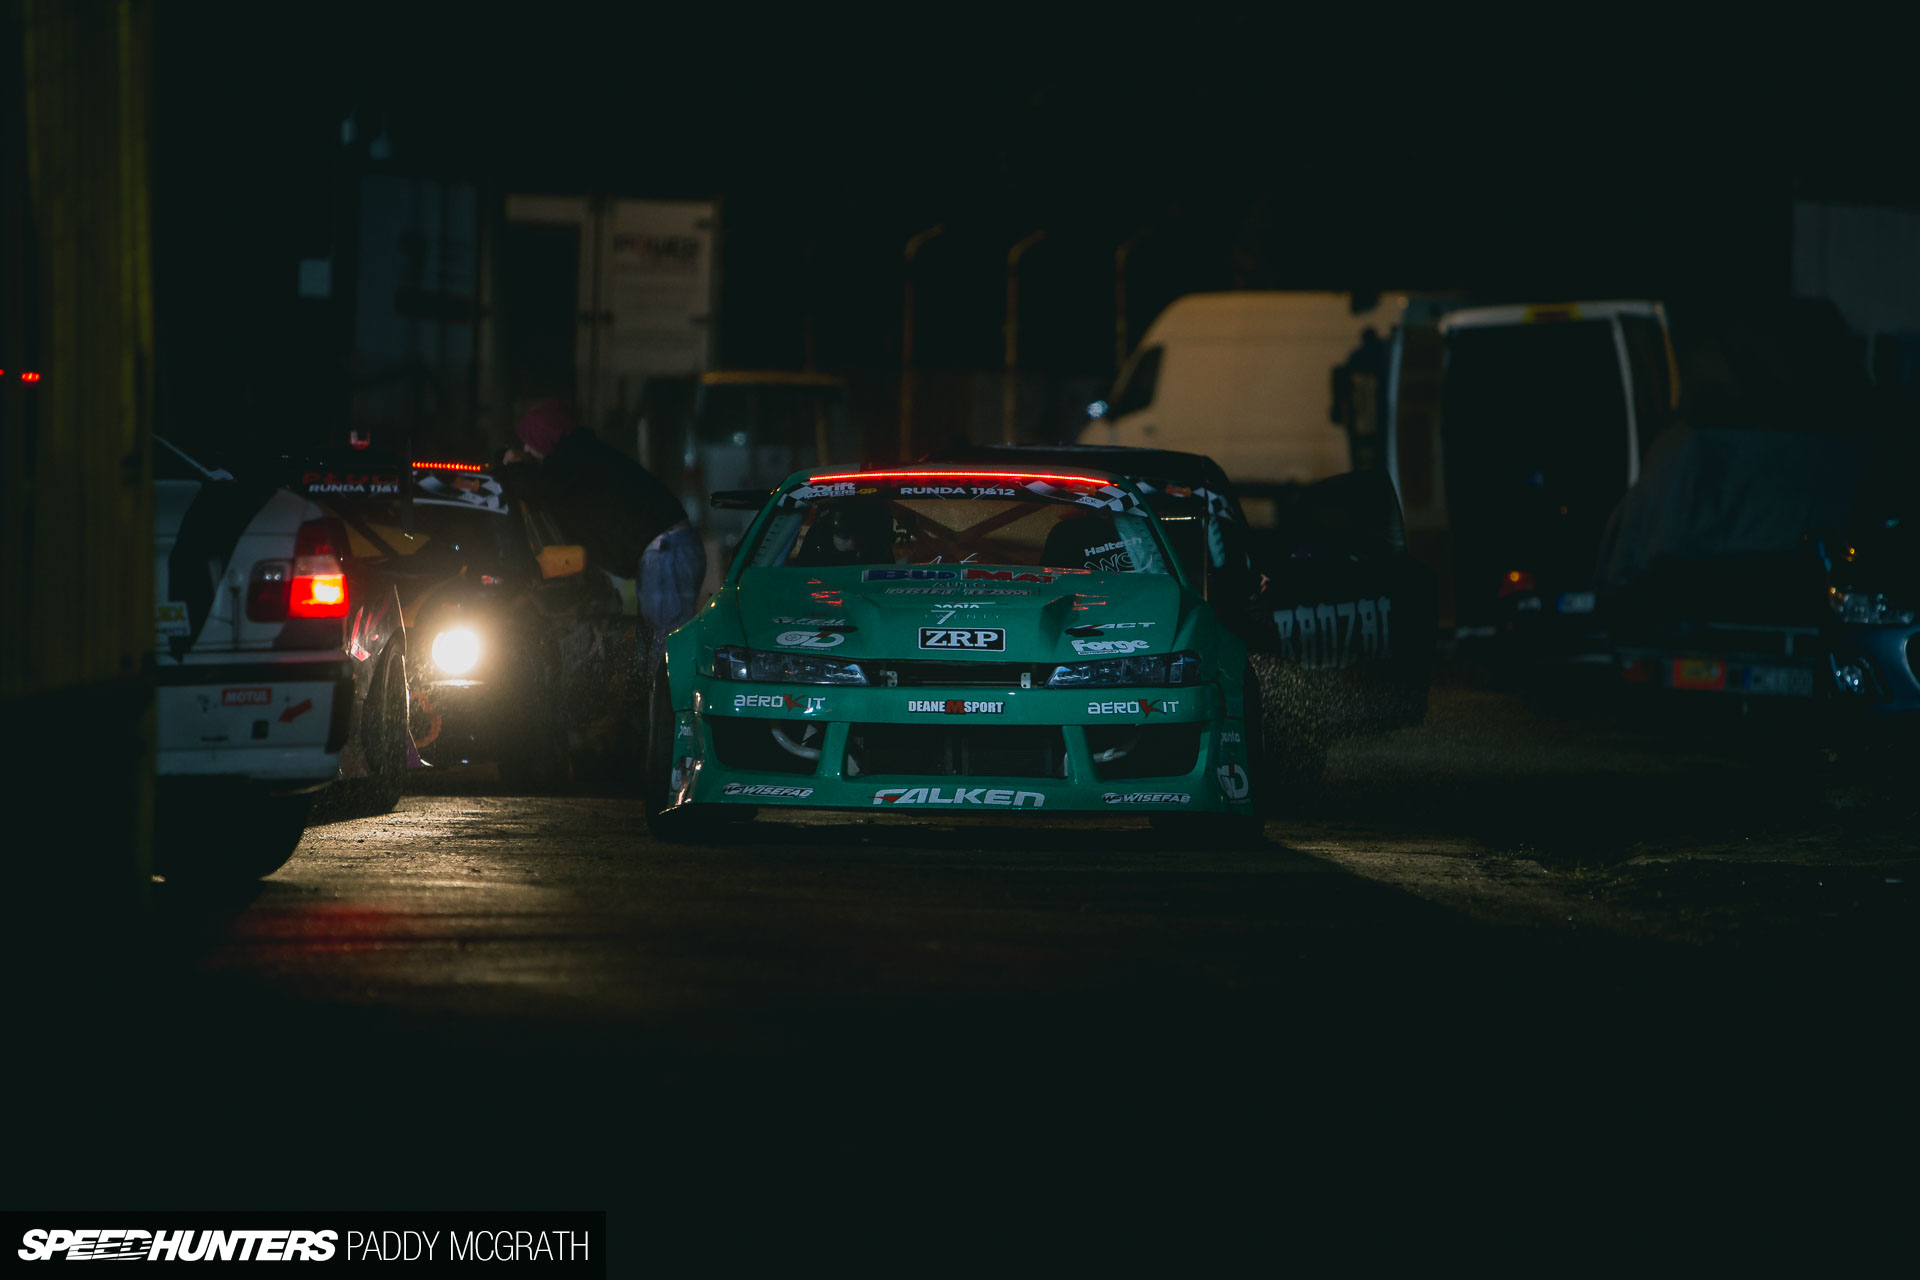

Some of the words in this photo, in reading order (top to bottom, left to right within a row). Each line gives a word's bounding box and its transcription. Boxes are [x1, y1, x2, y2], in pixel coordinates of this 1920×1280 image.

[309, 484, 365, 493] RUNDA
[901, 487, 966, 495] RUNDA
[970, 487, 1015, 496] 11&12
[925, 630, 998, 648] ZRP
[1071, 639, 1150, 654] Forge
[873, 788, 1046, 807] FALKEN
[1119, 793, 1191, 804] WISEFAB
